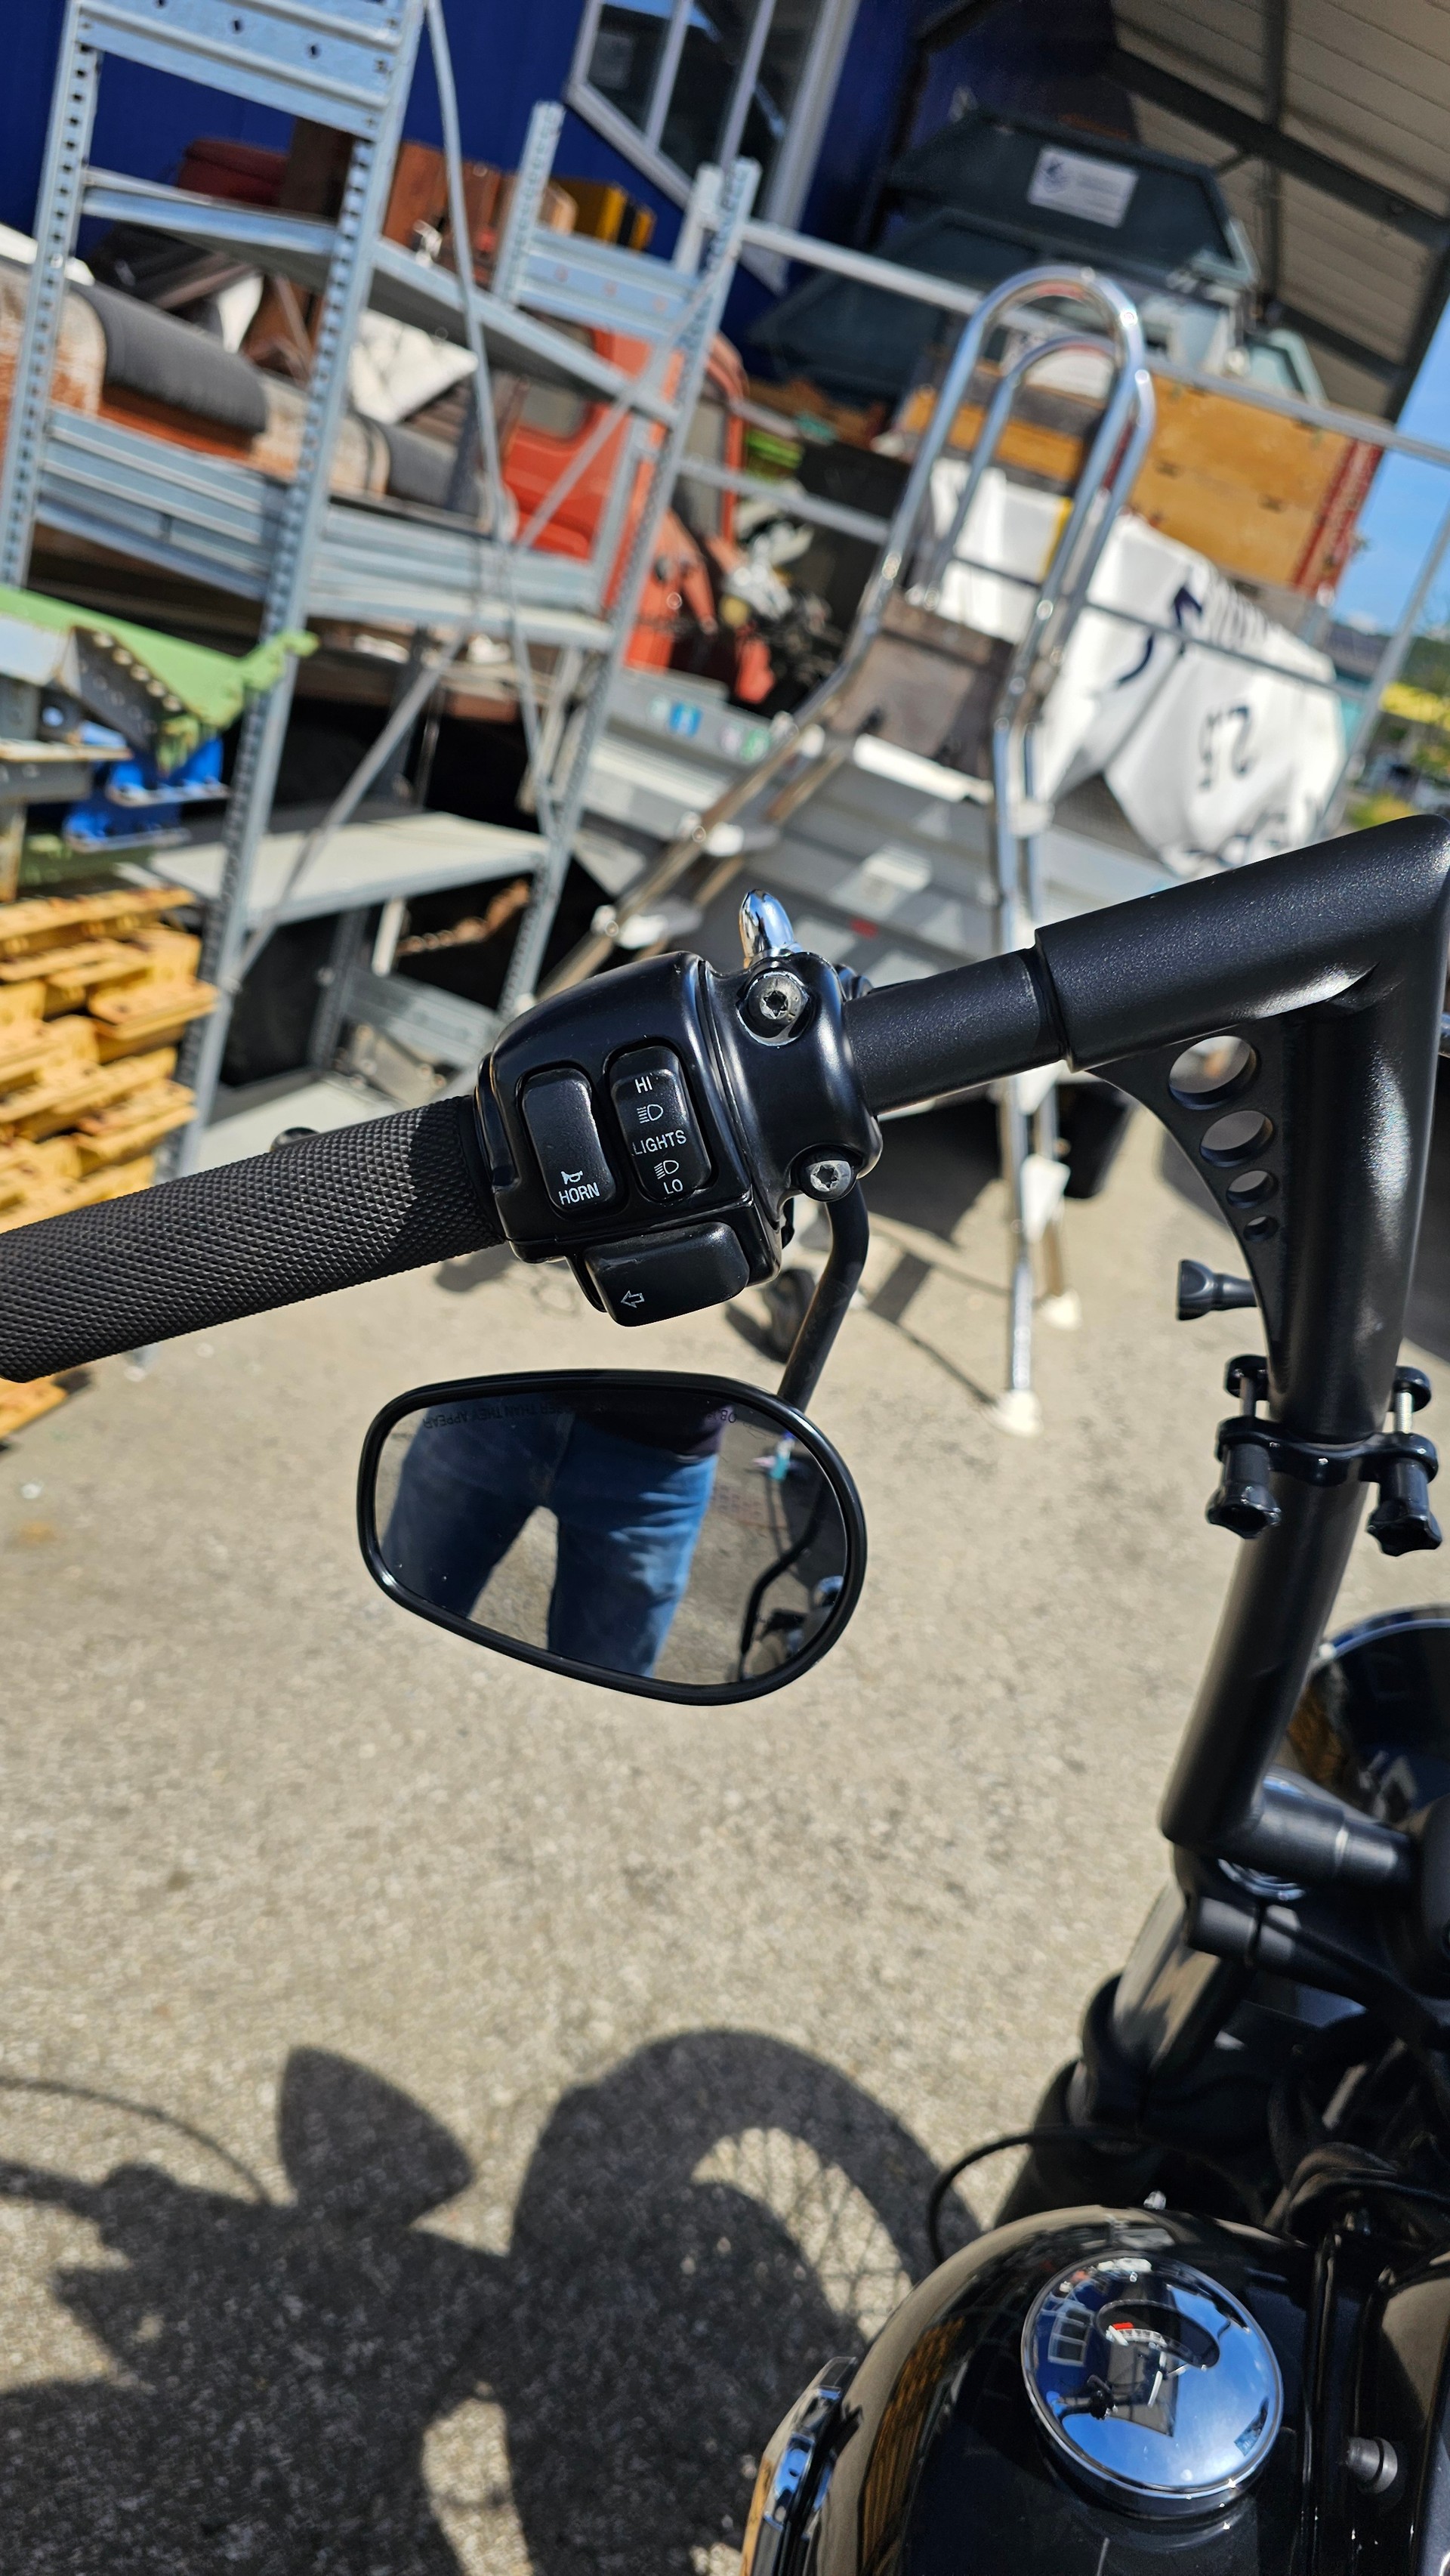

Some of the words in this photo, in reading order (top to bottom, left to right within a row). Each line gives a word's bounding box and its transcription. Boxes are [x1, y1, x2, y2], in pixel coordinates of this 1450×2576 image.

[634, 1076, 652, 1093] HI
[632, 1130, 686, 1155] LIGHTS
[558, 1182, 600, 1205] HORN
[664, 1178, 683, 1194] LO
[423, 1410, 467, 1429] APPEAR
